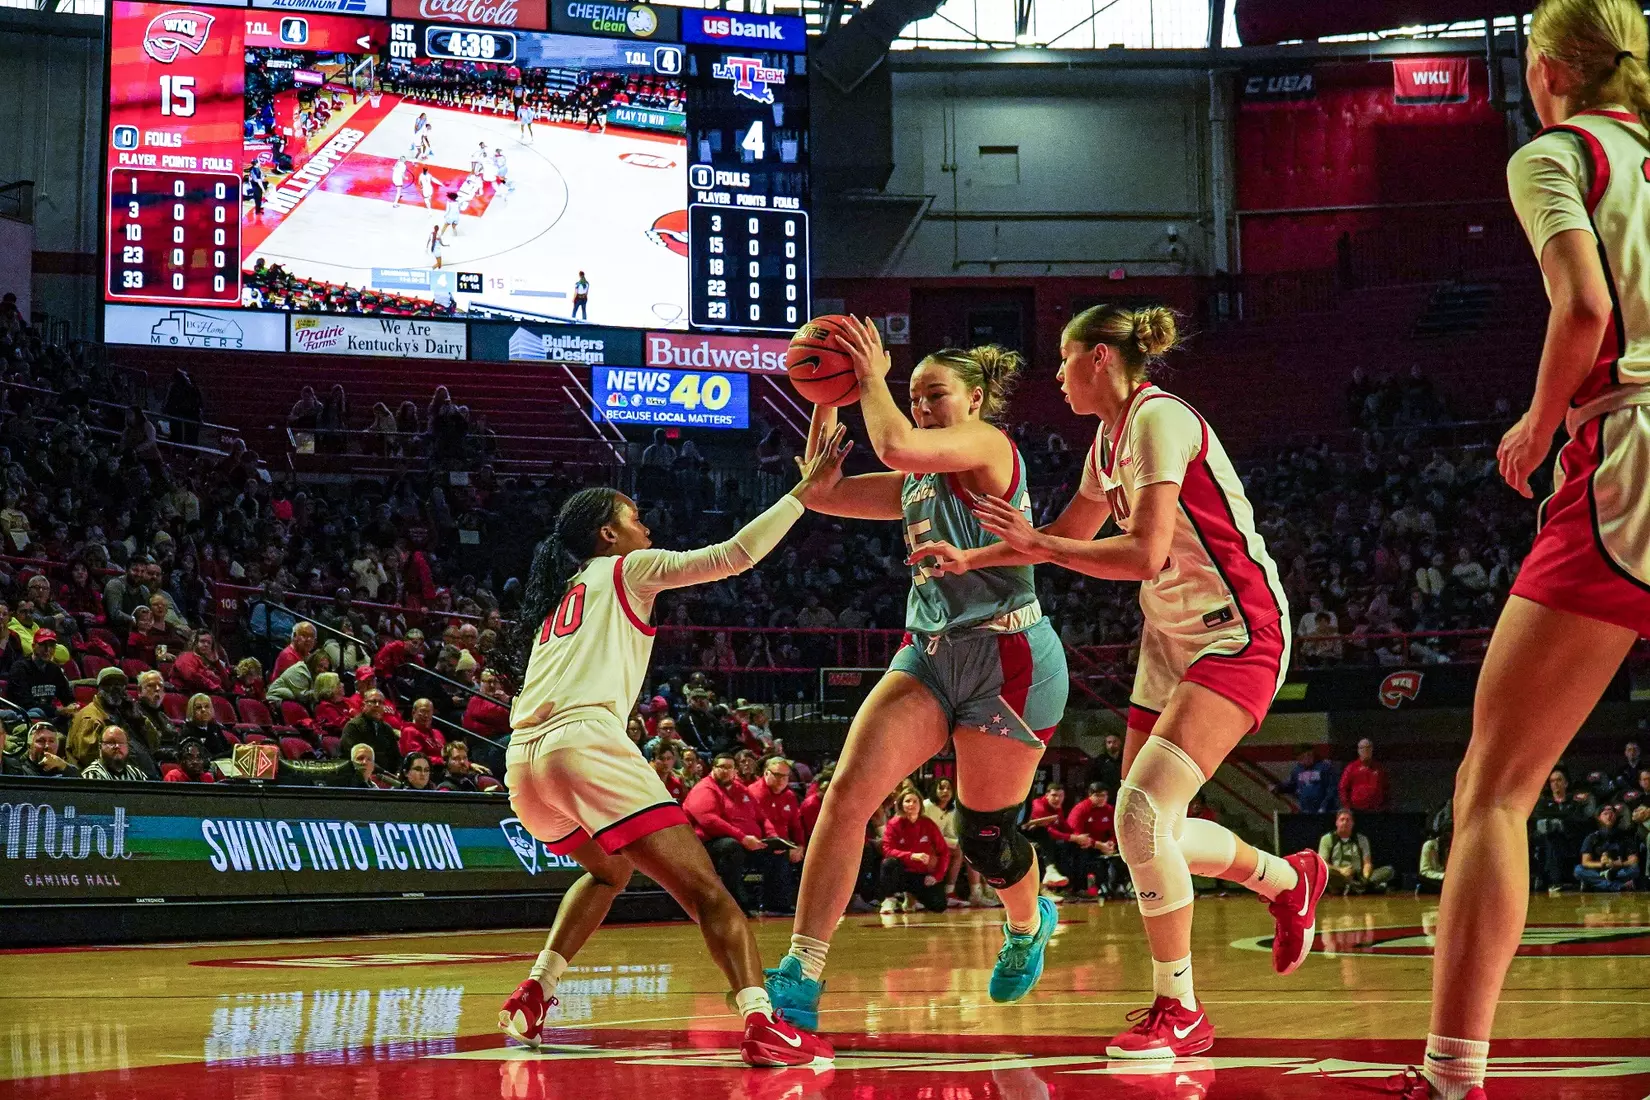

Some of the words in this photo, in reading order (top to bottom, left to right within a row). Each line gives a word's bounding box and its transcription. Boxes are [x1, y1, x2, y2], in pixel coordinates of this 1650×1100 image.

[272, 0, 337, 9] ALUMINUM
[420, 0, 518, 26] CocaCola
[567, 3, 626, 21] CHEETAH
[163, 19, 197, 36] WKU
[287, 20, 302, 42] 4
[391, 23, 414, 41] 1ST
[592, 19, 626, 33] Clean
[448, 33, 495, 58] 4:39
[662, 51, 675, 71] 4
[713, 65, 734, 79] LA
[1412, 71, 1449, 85] WKU
[160, 75, 195, 117] 15
[616, 110, 635, 121] PLAY
[637, 112, 647, 123] TO
[649, 113, 664, 126] WIN
[122, 130, 132, 146] 0
[145, 132, 182, 148] FOULS
[741, 121, 765, 160] 4
[119, 152, 156, 166] PLAYER
[162, 156, 197, 169] POINTS
[203, 158, 233, 171] FOULS
[261, 127, 364, 214] HILLTOPPERS
[131, 177, 137, 195] 1
[174, 180, 184, 198] 0
[215, 182, 225, 200] 0
[698, 170, 708, 185] 0
[716, 171, 750, 187] FOULS
[697, 191, 730, 204] PLAYER
[737, 194, 766, 207] POINTS
[773, 196, 799, 209] FOULS
[129, 202, 139, 218] 3
[174, 204, 184, 221] 0
[215, 206, 225, 223] 0
[126, 224, 142, 242] 10
[174, 226, 184, 243] 0
[215, 229, 225, 245] 0
[711, 215, 721, 232] 3
[749, 218, 759, 234] 0
[785, 220, 795, 237] 0
[123, 246, 143, 264] 23
[173, 249, 184, 266] 0
[214, 251, 225, 268] 0
[709, 237, 724, 253] 15
[749, 239, 759, 256] 0
[786, 242, 795, 258] 0
[709, 259, 724, 275] 18
[749, 261, 759, 278] 0
[786, 264, 796, 280] 0
[123, 271, 143, 288] 33
[173, 273, 183, 290] 0
[214, 275, 225, 292] 0
[489, 278, 505, 289] 15
[708, 280, 726, 296] 22
[749, 282, 760, 299] 0
[786, 285, 796, 301] 0
[708, 302, 726, 319] 23
[750, 304, 760, 321] 0
[786, 306, 796, 323] 0
[199, 321, 225, 334] Home
[295, 325, 345, 343] Prairie
[380, 320, 401, 335] We
[407, 321, 431, 336] Are
[150, 335, 243, 348] MOVERS
[303, 339, 337, 351] Farms
[347, 335, 419, 358] Kentucky's
[425, 339, 463, 360] Dairy
[542, 334, 604, 350] Builders
[553, 348, 604, 365] Design
[649, 337, 791, 371] Budweise
[606, 370, 671, 392] NEWS
[670, 374, 732, 410] 40
[606, 410, 651, 420] BECAUSE
[653, 412, 686, 422] LOCAL
[688, 414, 733, 425] MATTERS
[539, 583, 587, 645] 10
[0, 802, 132, 859] Mint
[202, 819, 301, 872] SWING
[300, 822, 368, 871] INTO
[369, 822, 463, 871] ACTION
[24, 874, 80, 886] GAMING
[86, 874, 121, 886] HALL
